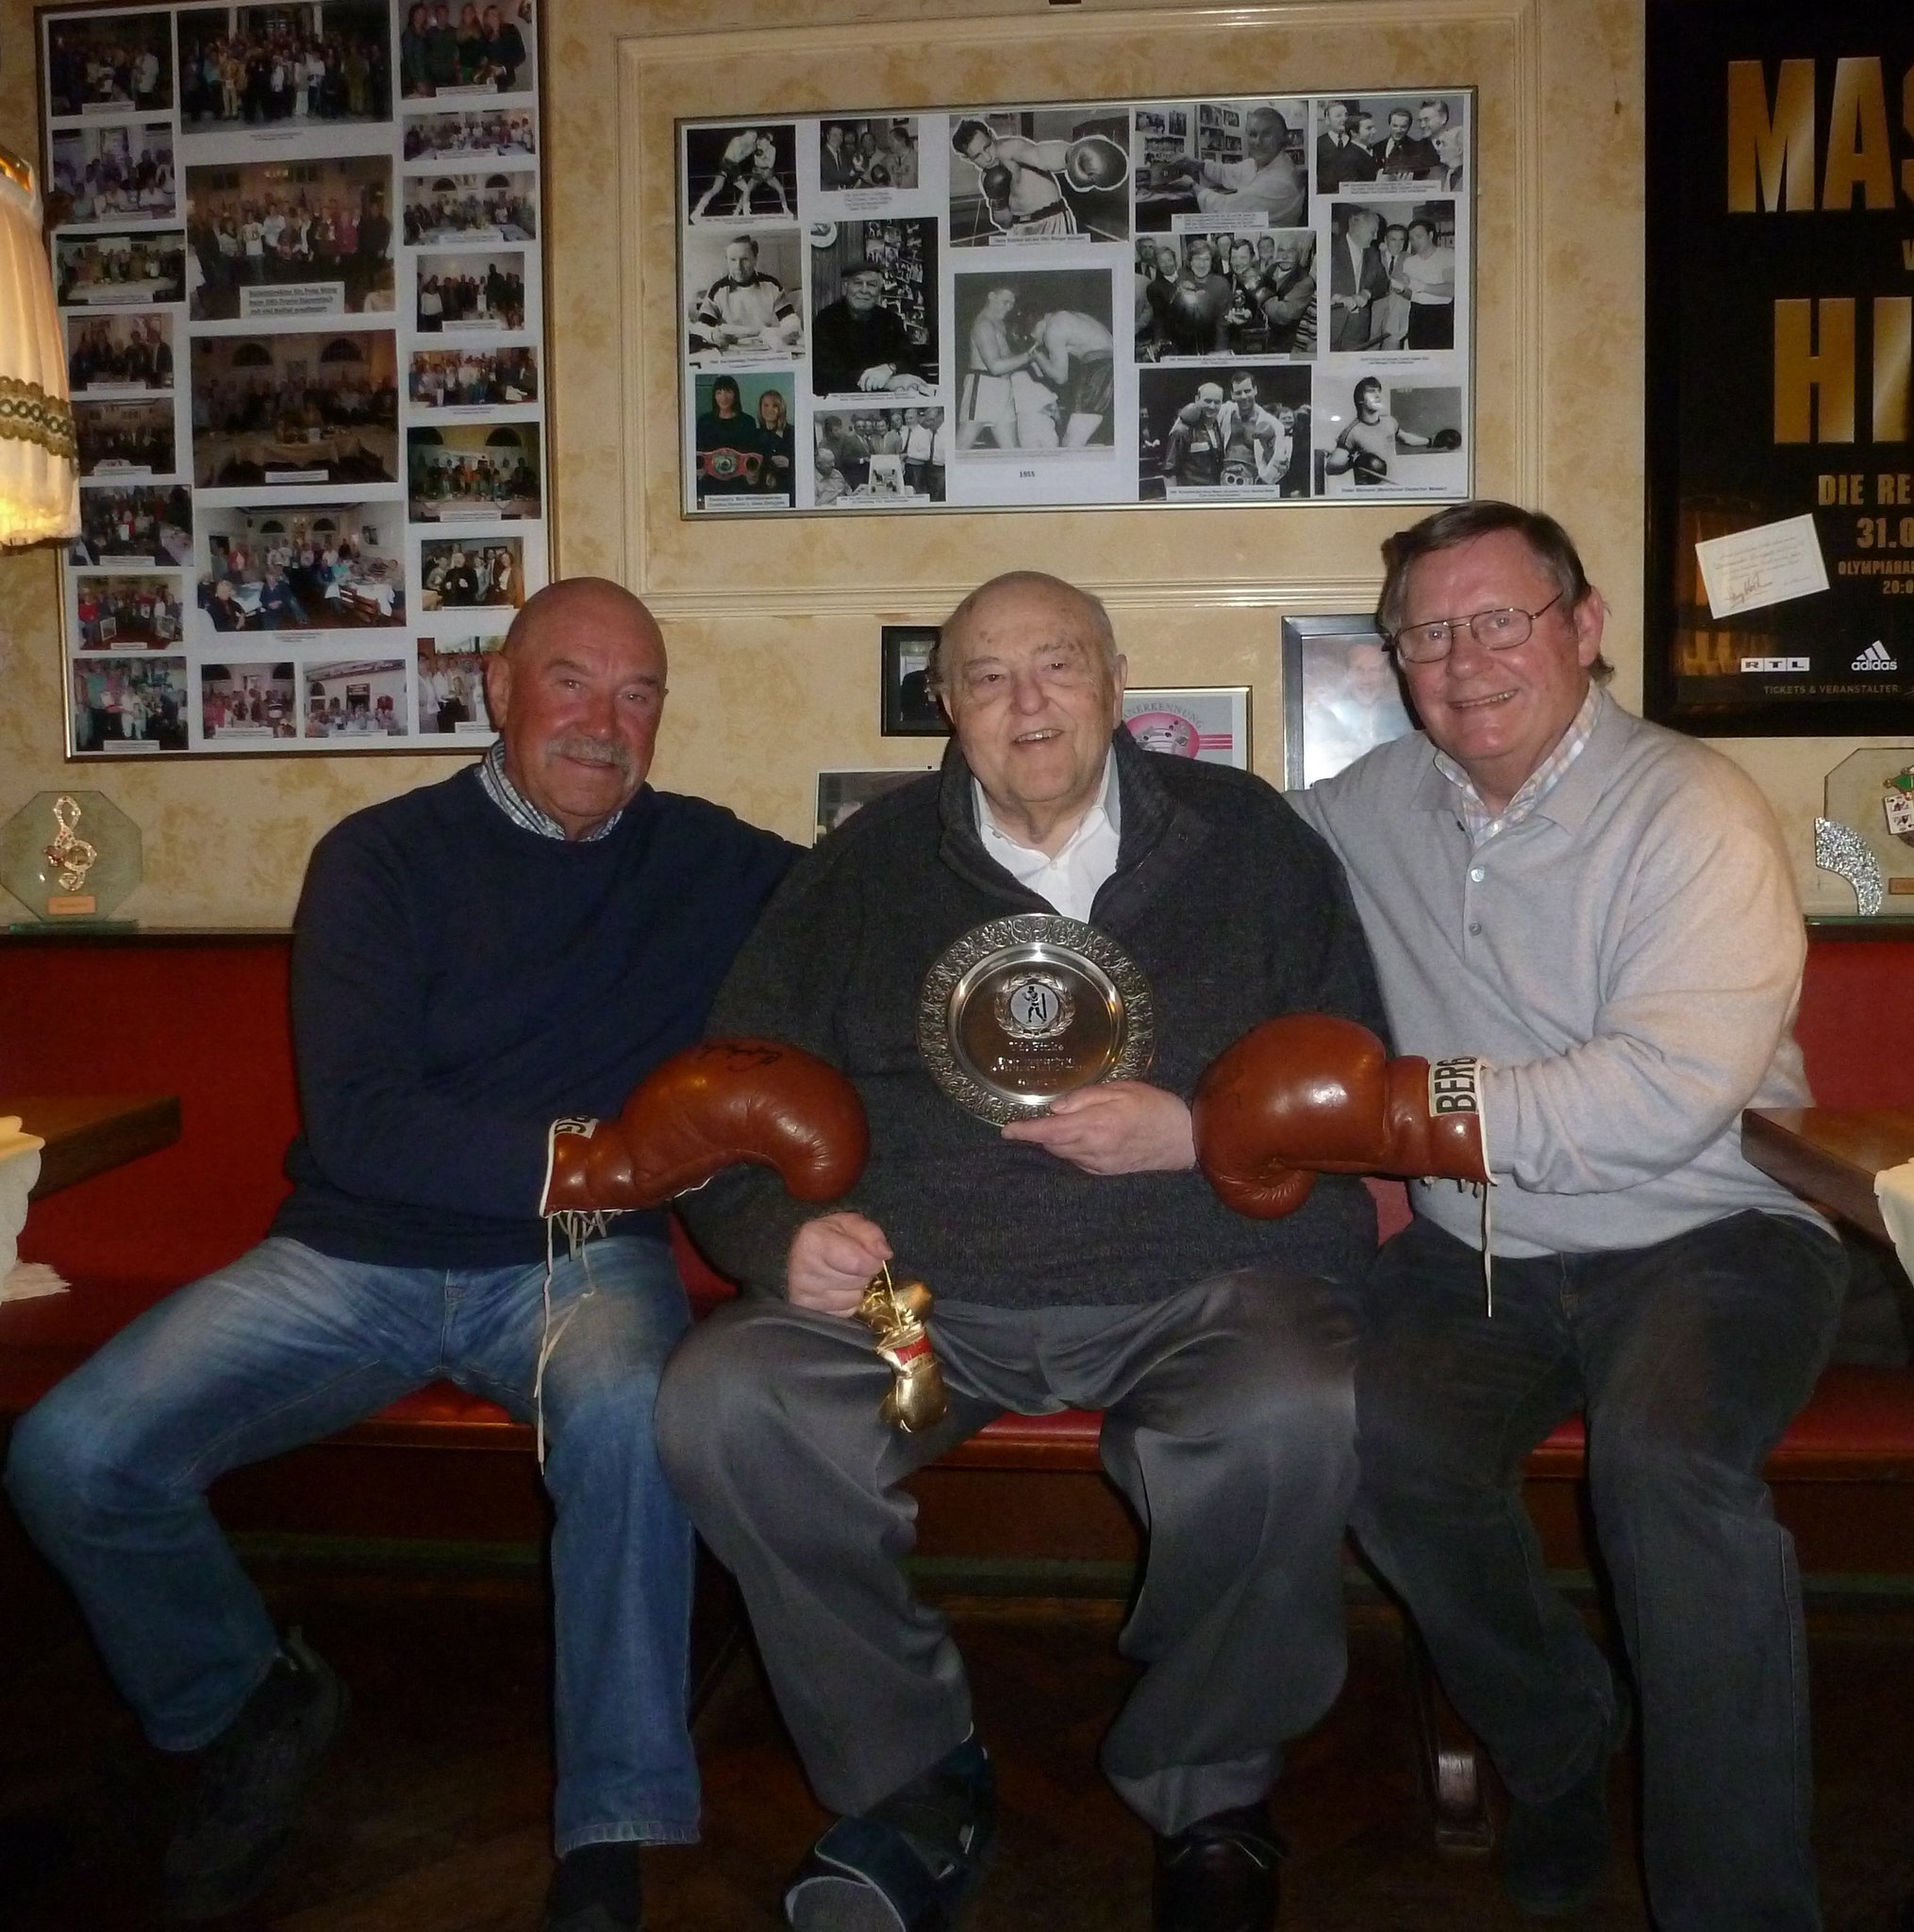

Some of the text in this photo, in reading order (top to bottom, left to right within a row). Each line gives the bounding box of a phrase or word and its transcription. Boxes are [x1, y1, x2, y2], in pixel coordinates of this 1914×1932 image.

[1726, 57, 1914, 213] MA
[1818, 474, 1911, 506] DIE RE
[1743, 658, 1898, 672] RTL adidas
[1764, 685, 1806, 694] TICKETS
[1434, 1057, 1477, 1113] BERG
